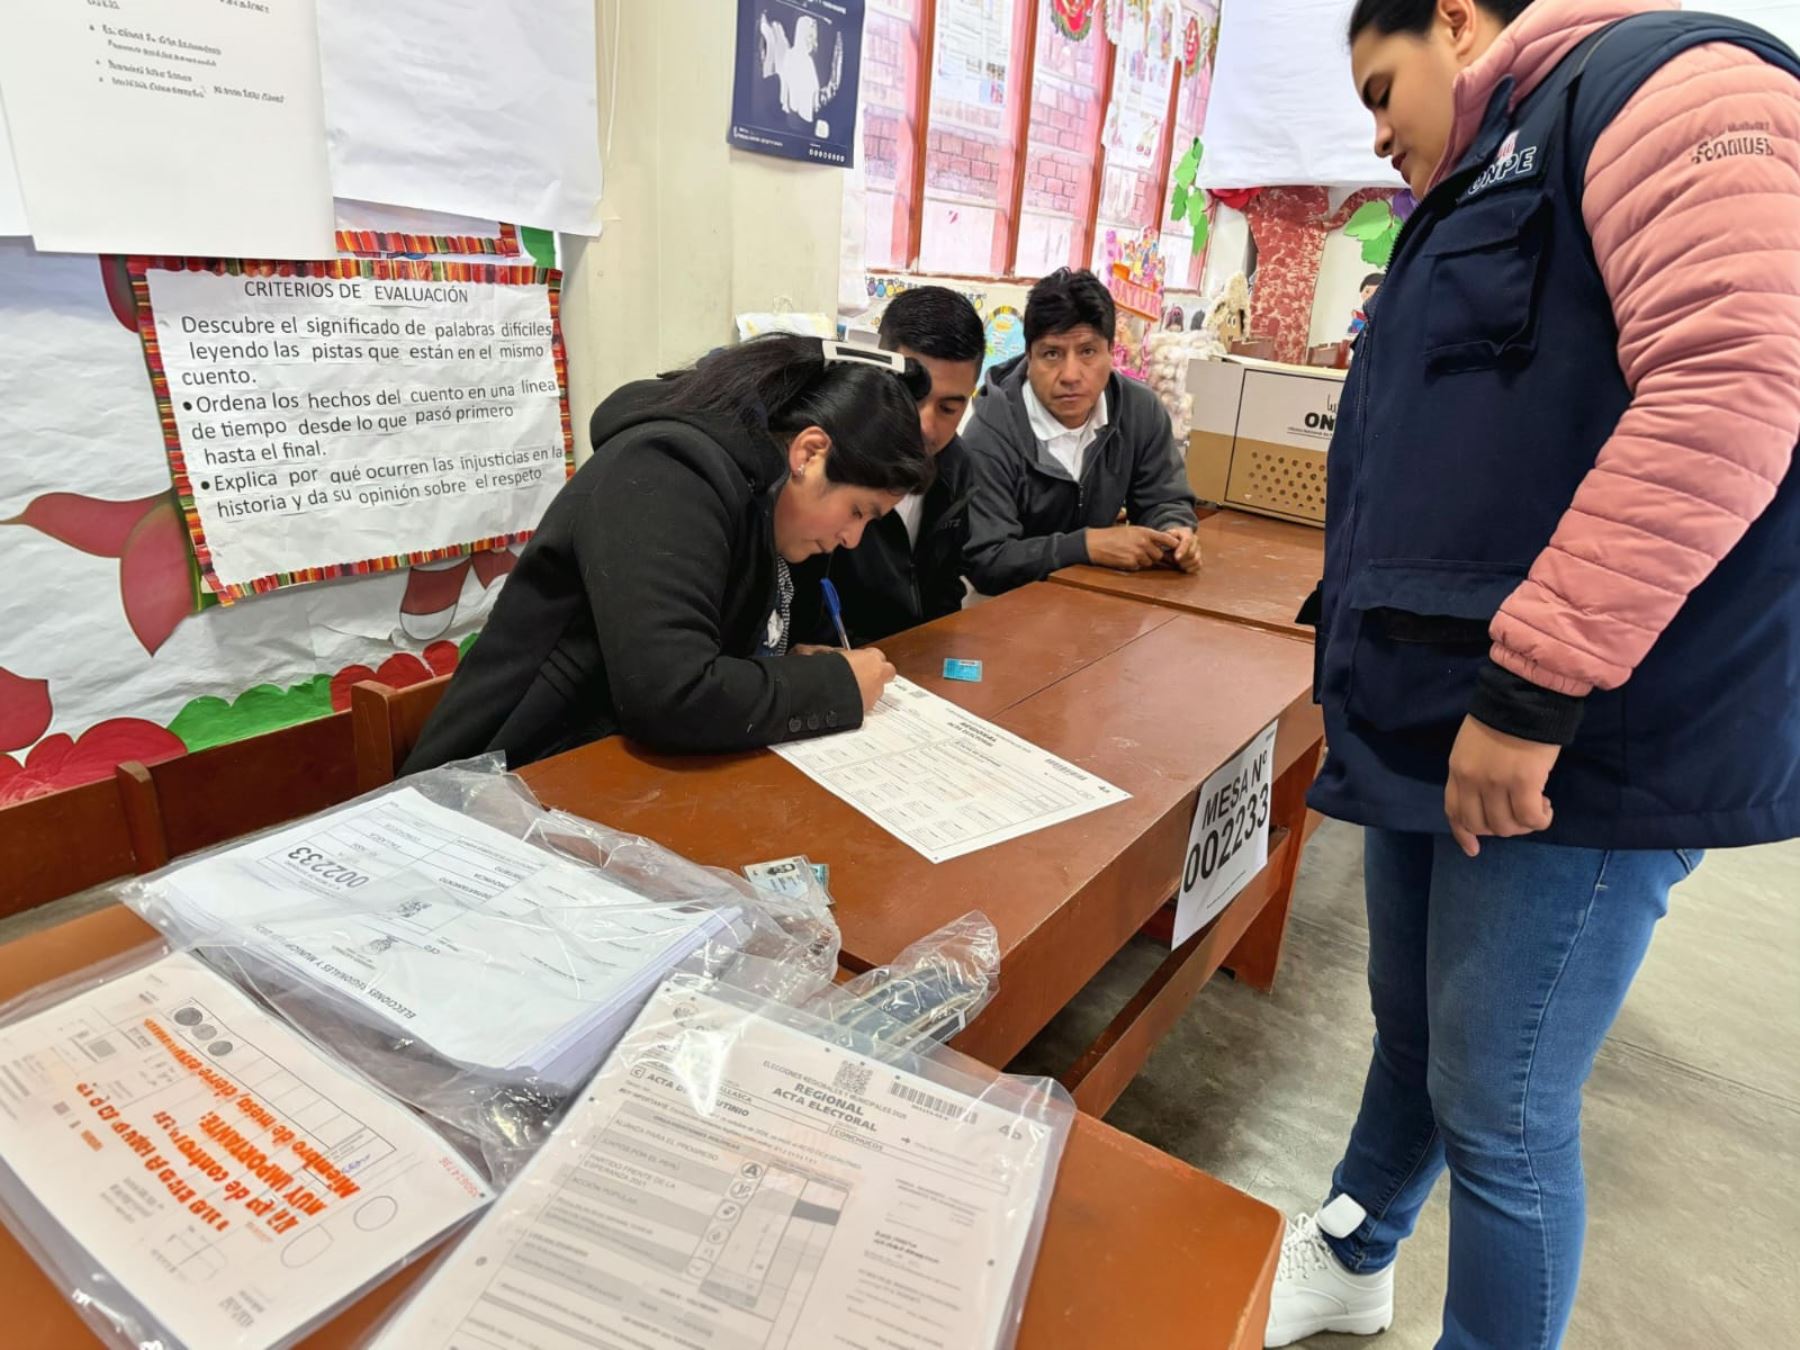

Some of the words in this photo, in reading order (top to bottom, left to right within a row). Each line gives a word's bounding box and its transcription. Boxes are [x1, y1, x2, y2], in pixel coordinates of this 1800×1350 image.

[245, 281, 333, 297] CRITERIOS
[339, 284, 361, 298] DE
[375, 286, 468, 303] EVALUACIÓN
[182, 316, 274, 333] Descubre
[281, 317, 297, 333] el
[307, 317, 399, 341] significado
[405, 320, 425, 335] de
[435, 322, 494, 340] palabras
[190, 341, 268, 363] leyendo
[274, 341, 299, 357] las
[312, 343, 363, 362] pistas
[368, 347, 399, 362] que
[410, 344, 453, 359] están
[458, 348, 475, 359] en
[479, 345, 491, 359] el
[500, 341, 543, 357] mismo
[182, 369, 256, 385] cuento.
[196, 394, 266, 413] Ordena
[272, 392, 299, 408] los
[308, 391, 370, 408] hechos
[376, 390, 401, 405] del
[411, 388, 463, 402] cuento
[469, 388, 486, 399] en
[491, 386, 514, 398] una
[192, 422, 216, 440] de
[221, 421, 288, 445] tiempo
[299, 417, 351, 435] desde
[357, 416, 373, 430] lo
[378, 416, 407, 436] que
[416, 406, 451, 424] pasó
[456, 405, 513, 423] primero
[1304, 412, 1335, 431] ON
[204, 448, 256, 468] hasta
[261, 443, 277, 460] el
[283, 440, 326, 458] final.
[214, 467, 277, 492] Explica
[289, 469, 318, 493] por
[330, 465, 361, 484] qué
[366, 463, 428, 479] ocurren
[433, 457, 454, 471] las
[460, 452, 532, 473] injusticias
[533, 450, 548, 460] en
[552, 444, 563, 457] la
[217, 495, 289, 517] historia
[292, 496, 304, 514] y
[308, 489, 328, 505] da
[333, 490, 351, 501] su
[359, 484, 420, 506] opinión
[424, 480, 466, 496] sobre
[476, 474, 487, 488] el
[492, 469, 541, 489] respeto
[1202, 768, 1248, 830] MESA
[1183, 782, 1268, 893] 002233
[288, 846, 369, 889] 002233
[369, 988, 416, 1019] ELECCIONES
[763, 1060, 802, 1080] ELECCIONES
[647, 1073, 675, 1090] ACTA
[715, 1099, 750, 1117] UTINIO
[772, 1087, 805, 1105] ACTA
[808, 1101, 878, 1132] ELECTORAL
[794, 1083, 864, 1116] REGIONAL
[271, 1124, 295, 1148] de
[291, 1140, 360, 1199] Miembro
[223, 1180, 250, 1201] de
[283, 1186, 328, 1217] MUY
